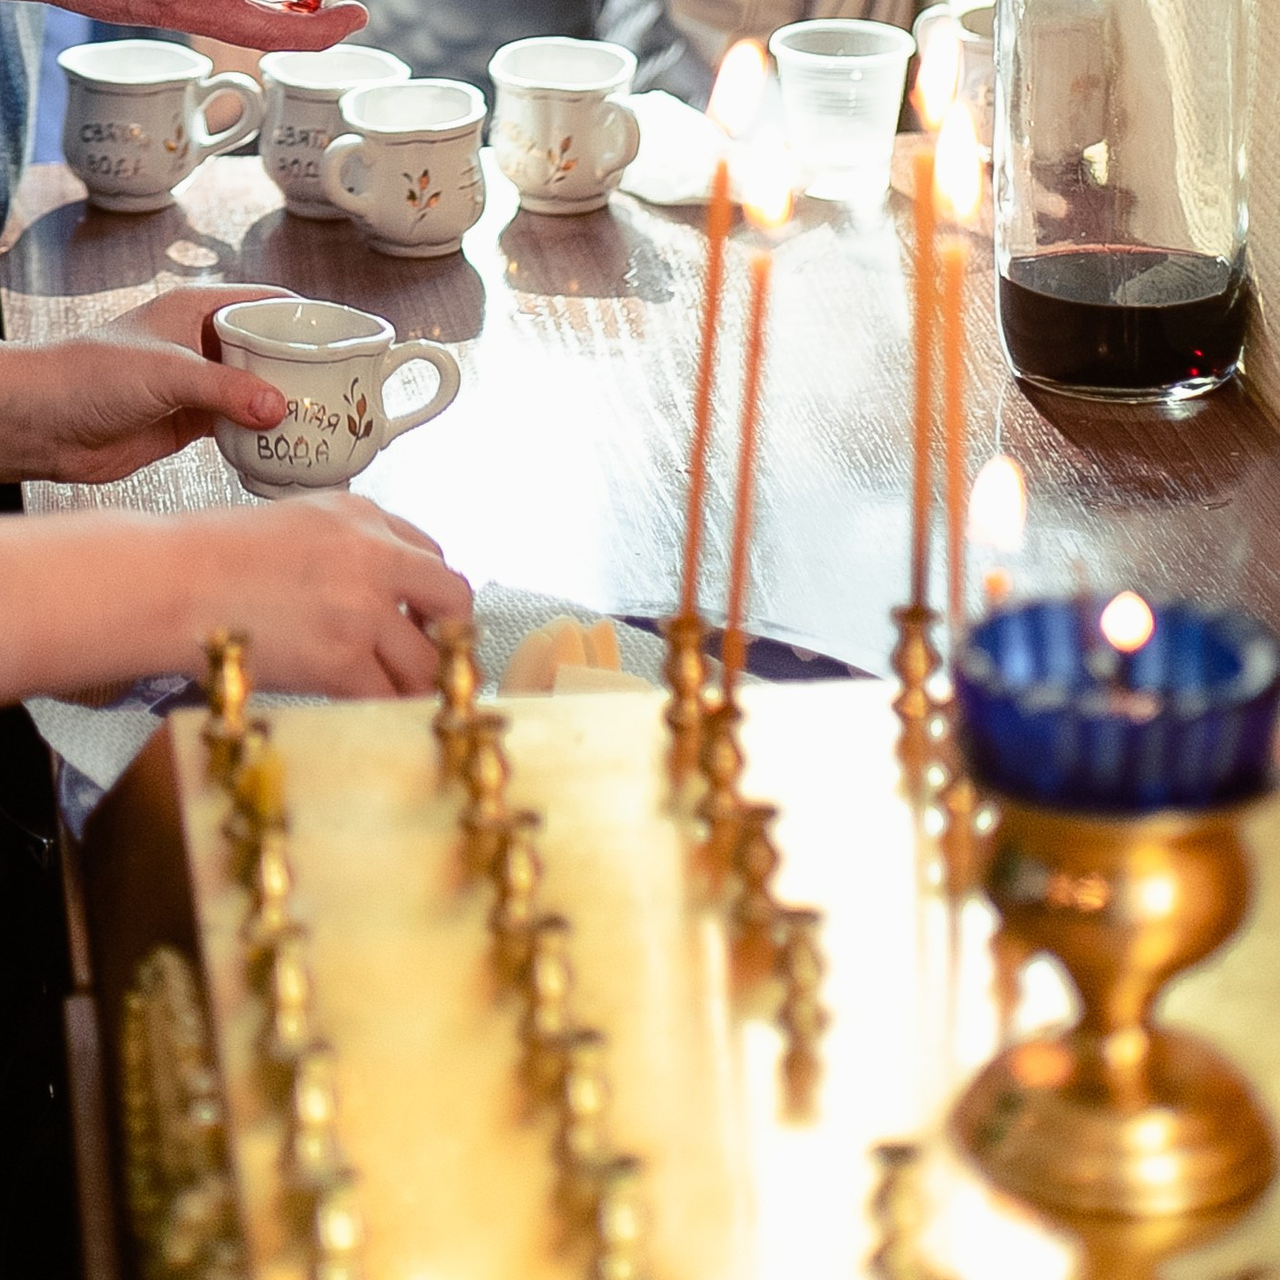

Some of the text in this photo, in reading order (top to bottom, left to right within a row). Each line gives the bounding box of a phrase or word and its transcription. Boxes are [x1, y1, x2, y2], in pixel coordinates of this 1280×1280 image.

[277, 157, 321, 179] ВОД
[285, 399, 341, 435] ЯТАЯ
[256, 433, 330, 468] ВОДА
